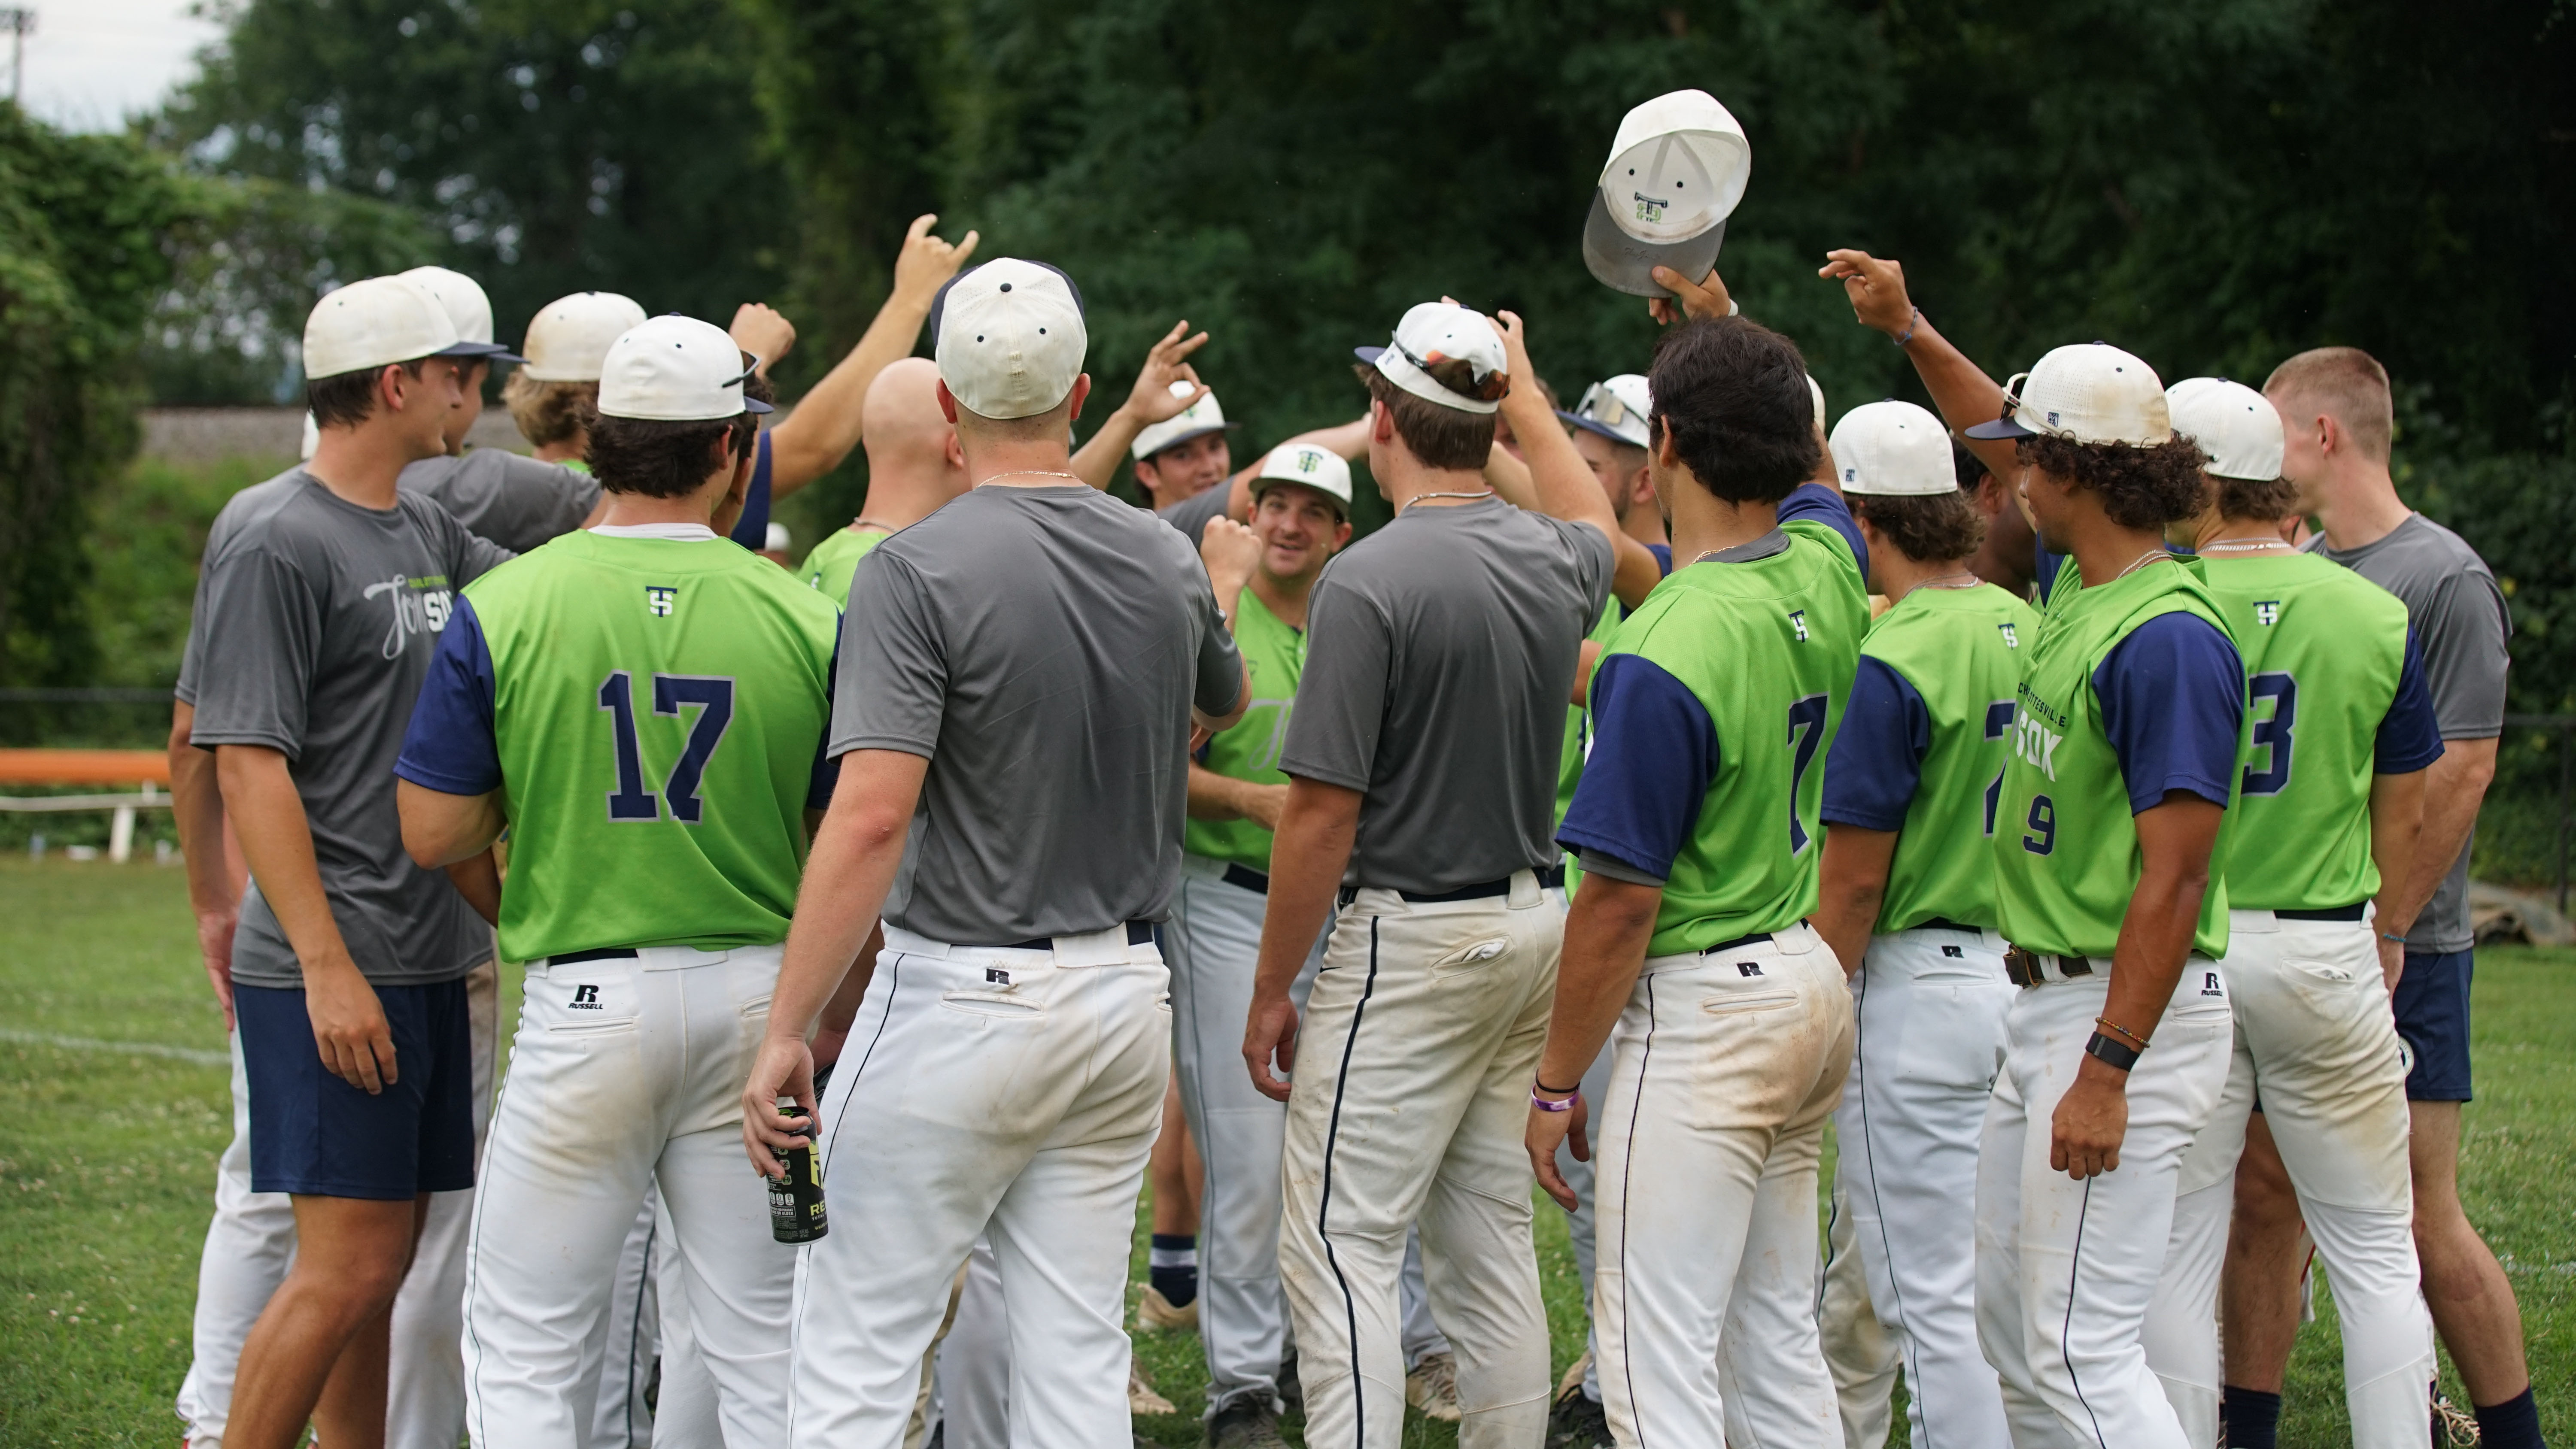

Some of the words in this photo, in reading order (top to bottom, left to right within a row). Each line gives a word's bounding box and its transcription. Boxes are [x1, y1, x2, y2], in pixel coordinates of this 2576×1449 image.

[597, 669, 736, 826] 17
[2017, 709, 2063, 782] SOX
[2240, 670, 2299, 797] 3
[1787, 691, 1828, 858] 7
[2023, 794, 2055, 857] 9
[574, 985, 599, 1003] R
[2206, 973, 2219, 989] R
[810, 1200, 825, 1216] RE
